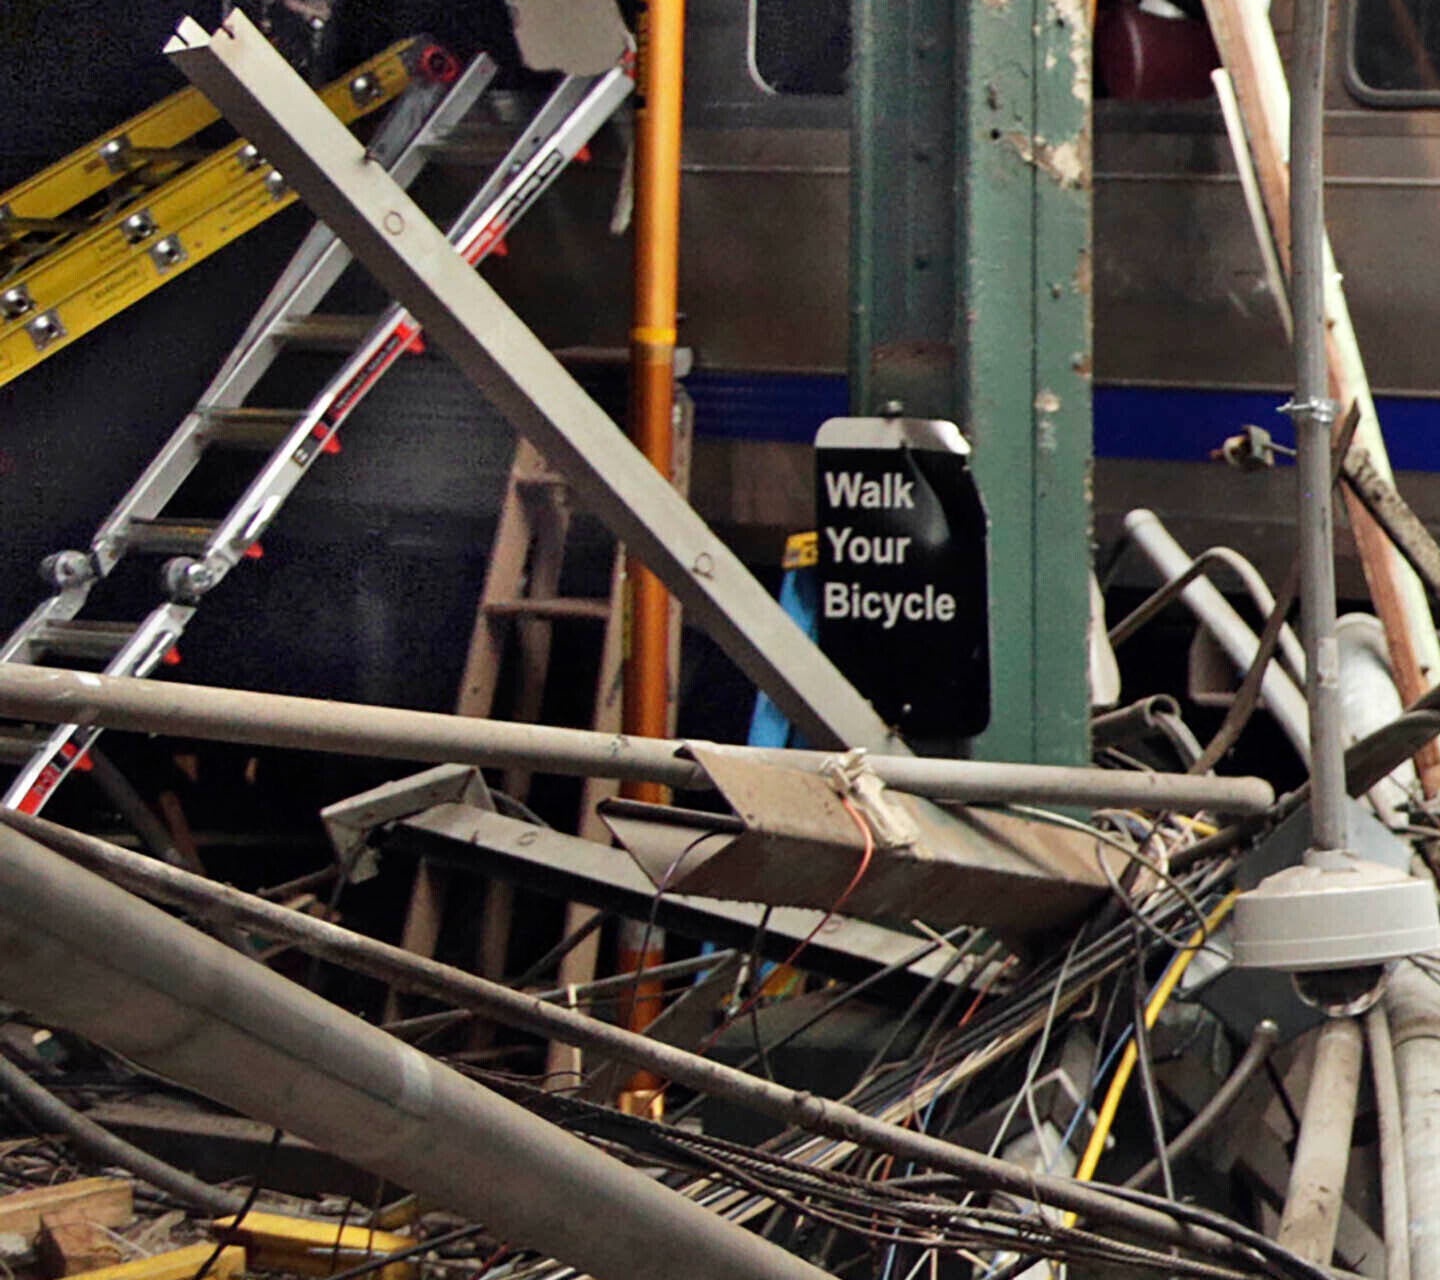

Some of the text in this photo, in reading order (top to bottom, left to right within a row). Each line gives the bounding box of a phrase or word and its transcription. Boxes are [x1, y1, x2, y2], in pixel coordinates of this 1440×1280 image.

[824, 471, 915, 510] Walk
[825, 527, 911, 565] Your
[823, 582, 956, 629] Bicycle
